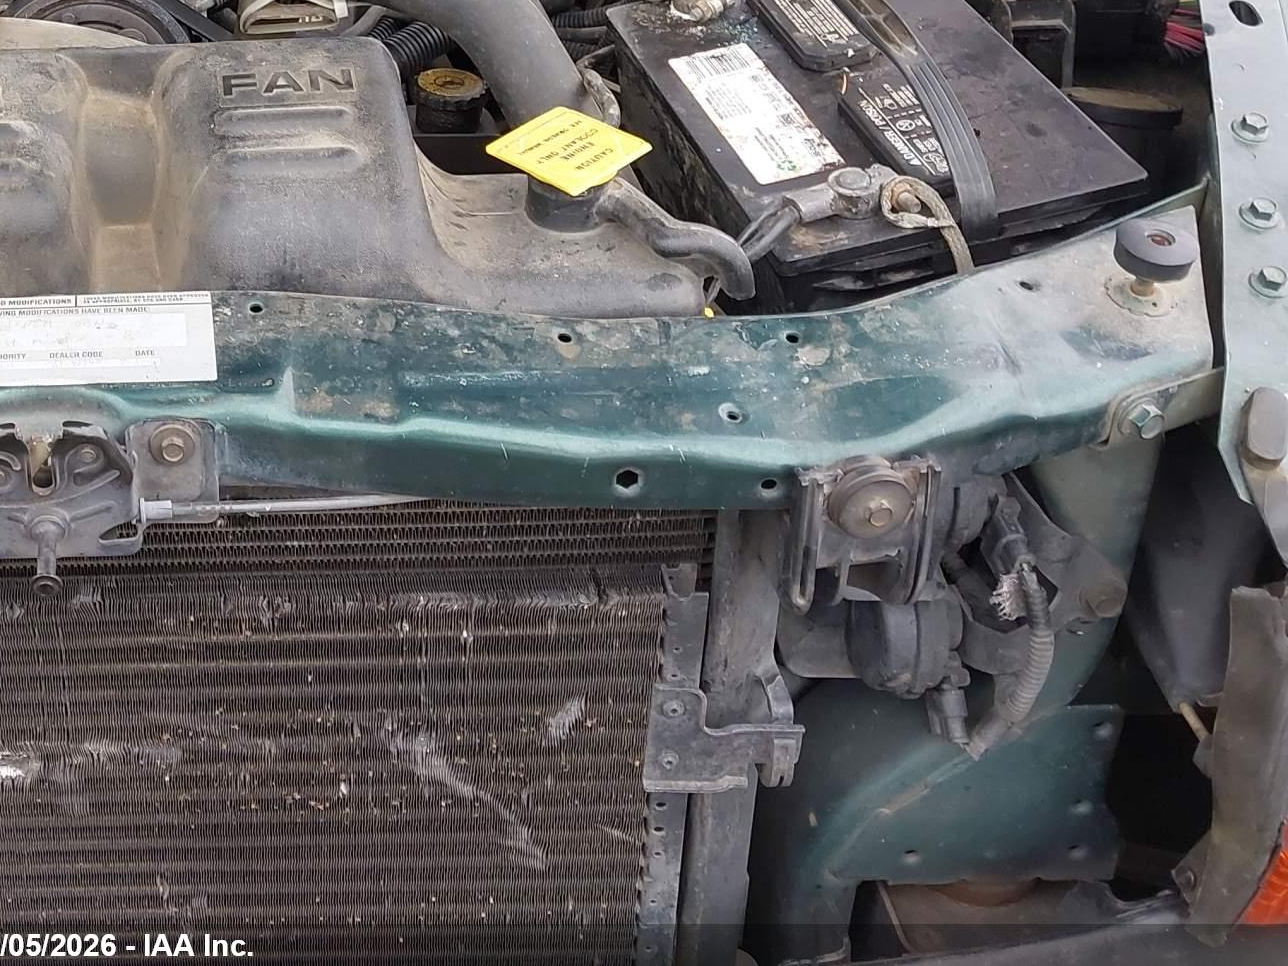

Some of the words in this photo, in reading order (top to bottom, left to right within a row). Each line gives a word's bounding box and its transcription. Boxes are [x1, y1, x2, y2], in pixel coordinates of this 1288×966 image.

[222, 68, 356, 97] FAN
[575, 147, 613, 170] CAUTION
[8, 298, 72, 306] MODIFICATIONS
[18, 308, 79, 316] MODIFICATIONS
[135, 349, 156, 357] DATE
